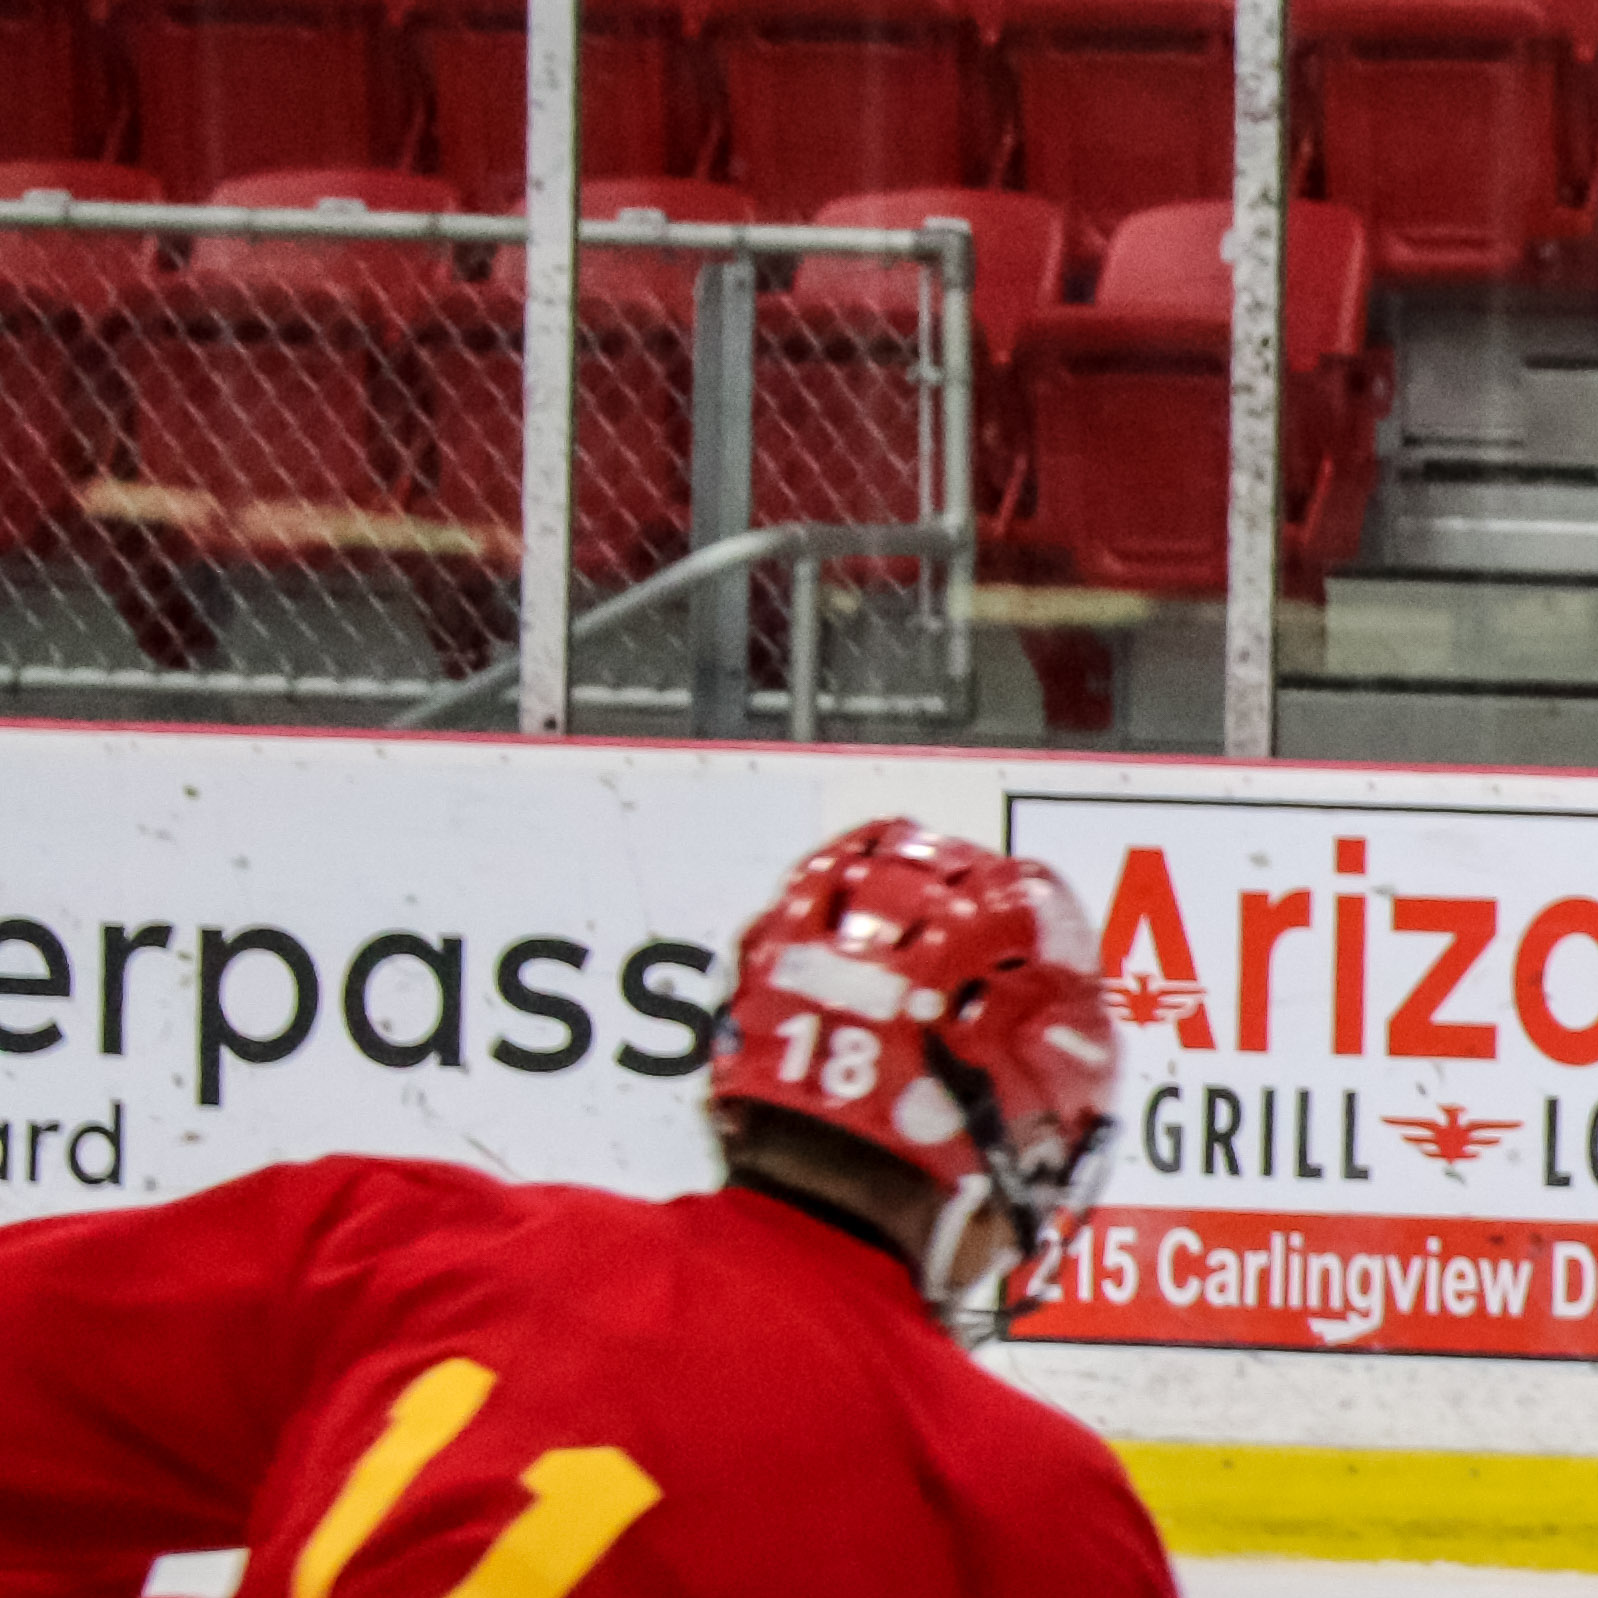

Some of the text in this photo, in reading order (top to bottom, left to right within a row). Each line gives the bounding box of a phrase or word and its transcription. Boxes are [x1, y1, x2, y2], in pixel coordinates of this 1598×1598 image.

[775, 1012, 883, 1101] 18
[0, 1101, 124, 1186] rd
[1142, 1084, 1371, 1181] GRILL
[1026, 1226, 1140, 1307] 215
[1156, 1227, 1533, 1344] Carlingview
